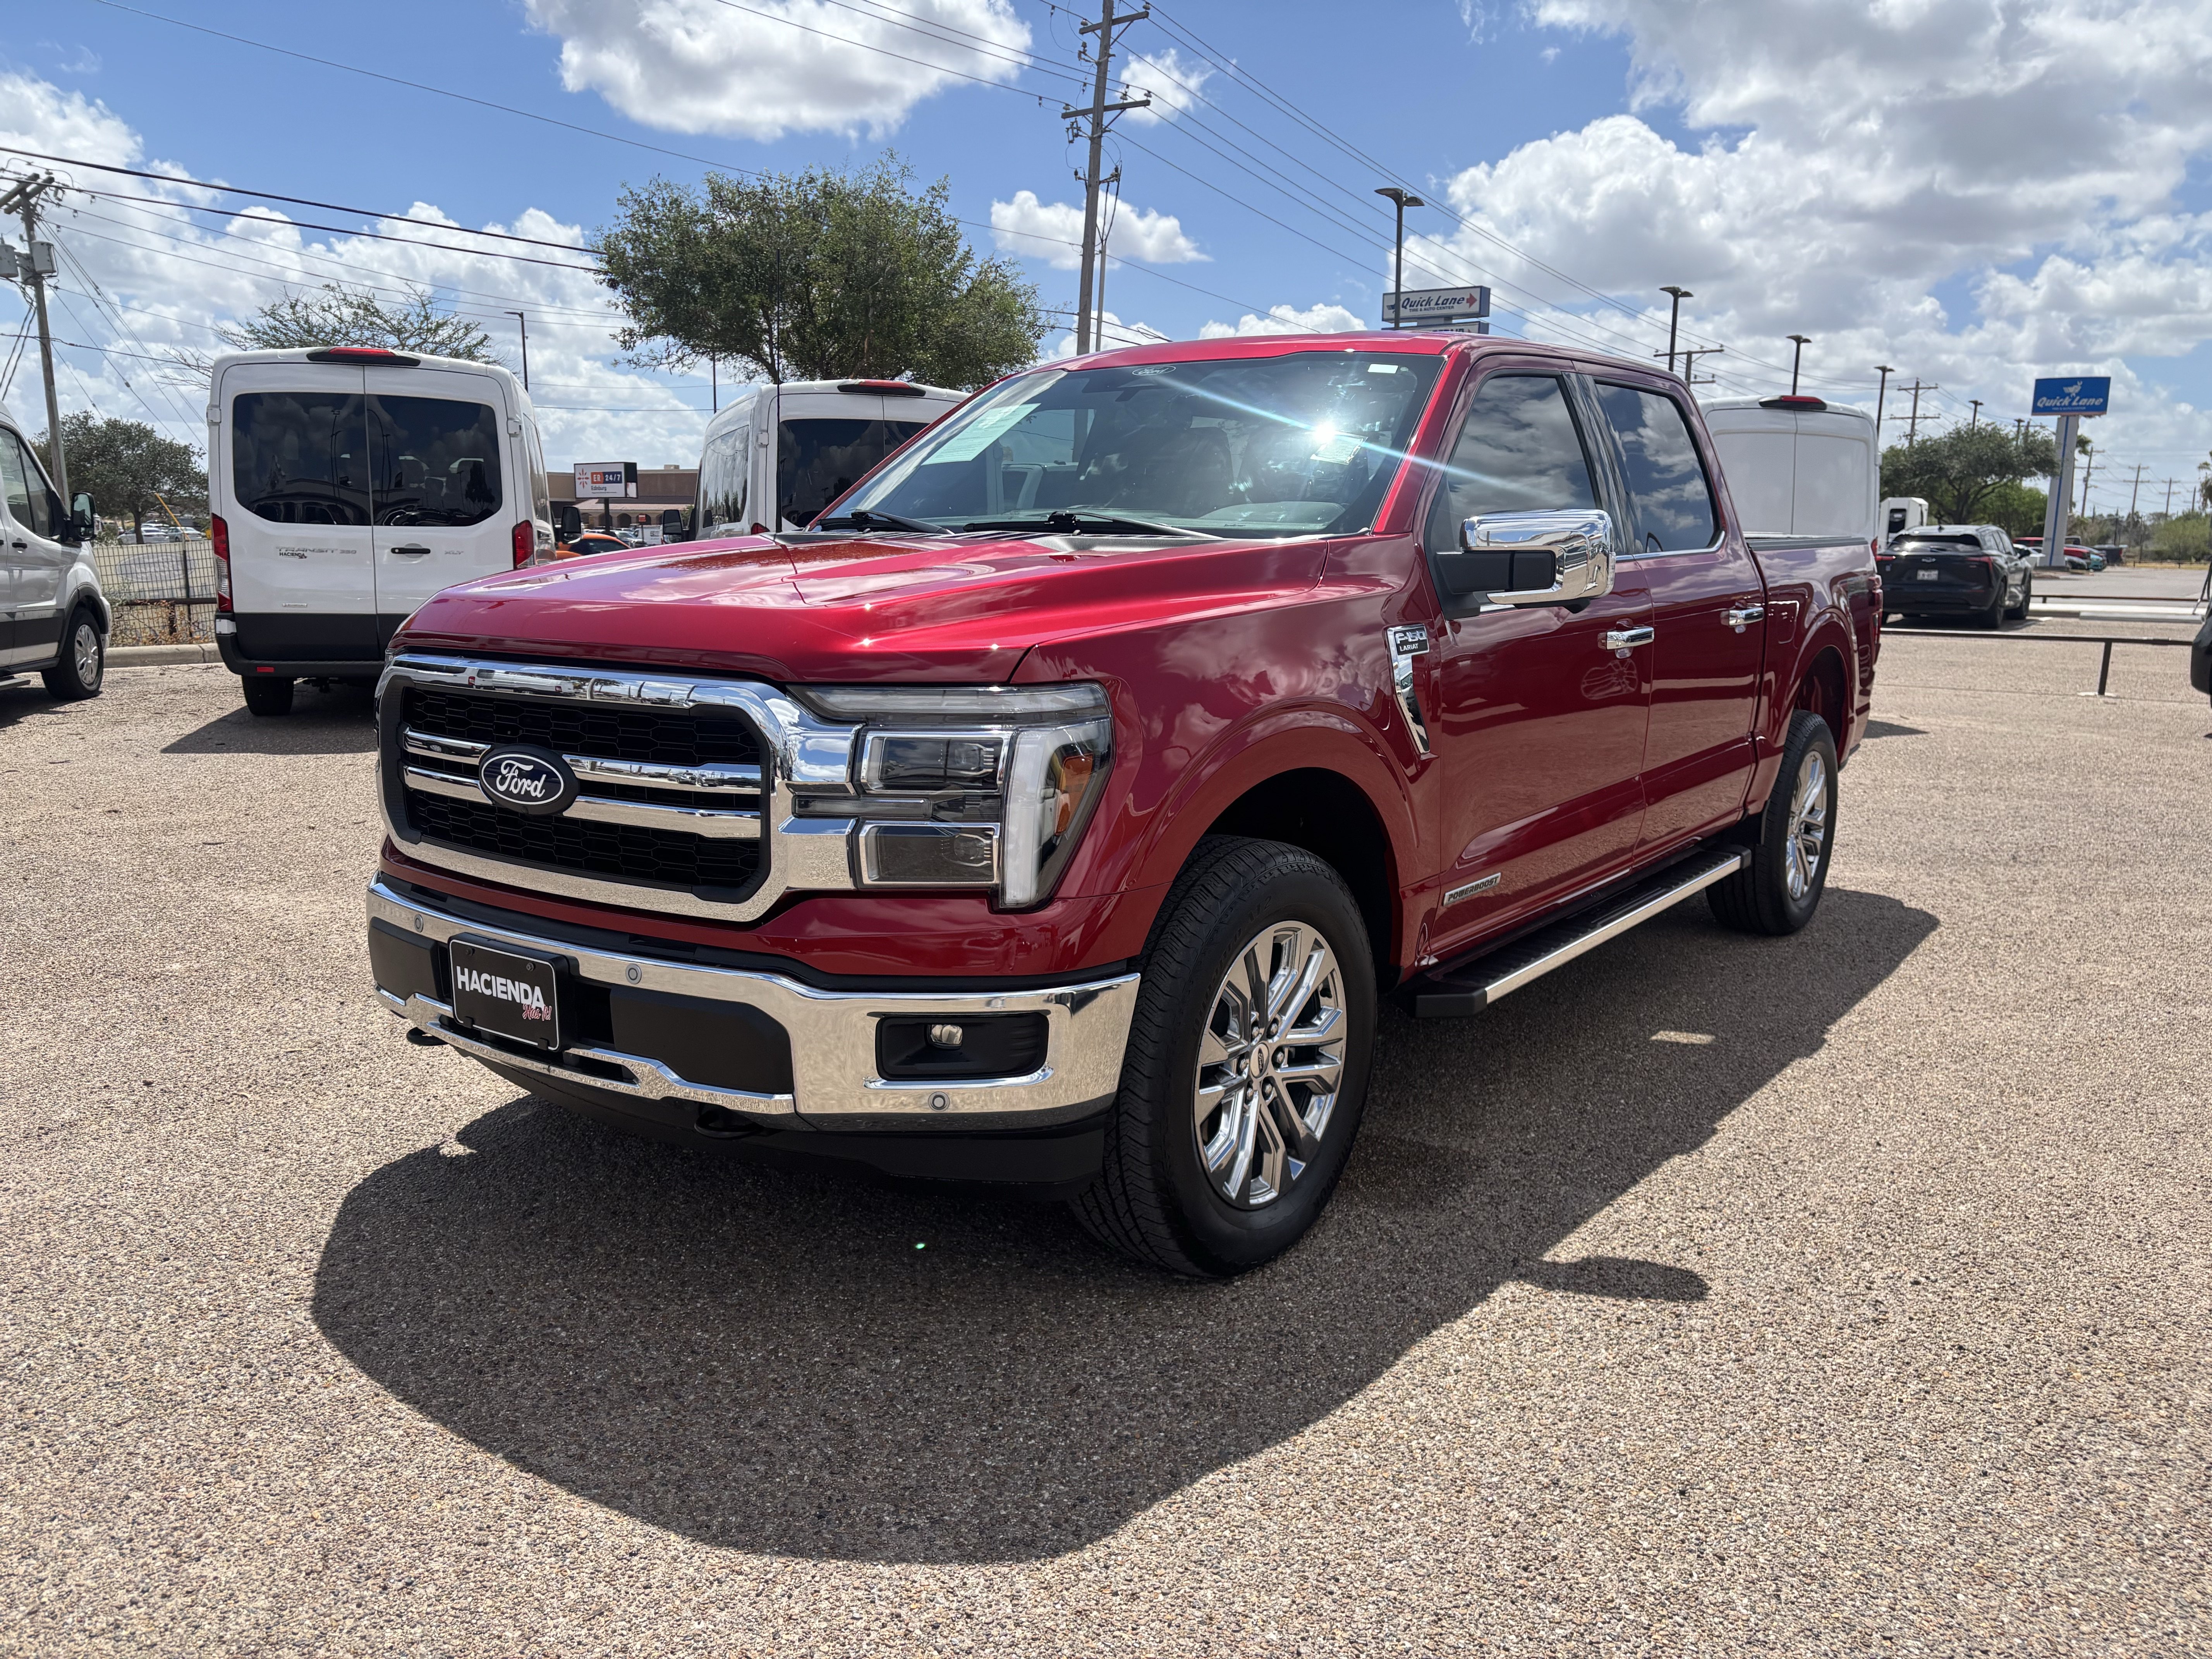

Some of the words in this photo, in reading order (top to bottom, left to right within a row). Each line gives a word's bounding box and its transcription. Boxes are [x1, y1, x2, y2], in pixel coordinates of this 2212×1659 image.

[1401, 296, 1434, 309] Quick
[1434, 295, 1465, 306] Lane
[2037, 396, 2071, 408] Quick
[2072, 396, 2104, 406] Lane
[1395, 630, 1427, 644] F-150
[1400, 643, 1419, 651] LARIAT
[496, 760, 547, 798] Ford
[1448, 876, 1499, 902] POWERBOOST
[456, 965, 546, 1011] HACIENDA
[522, 1003, 541, 1020] Has
